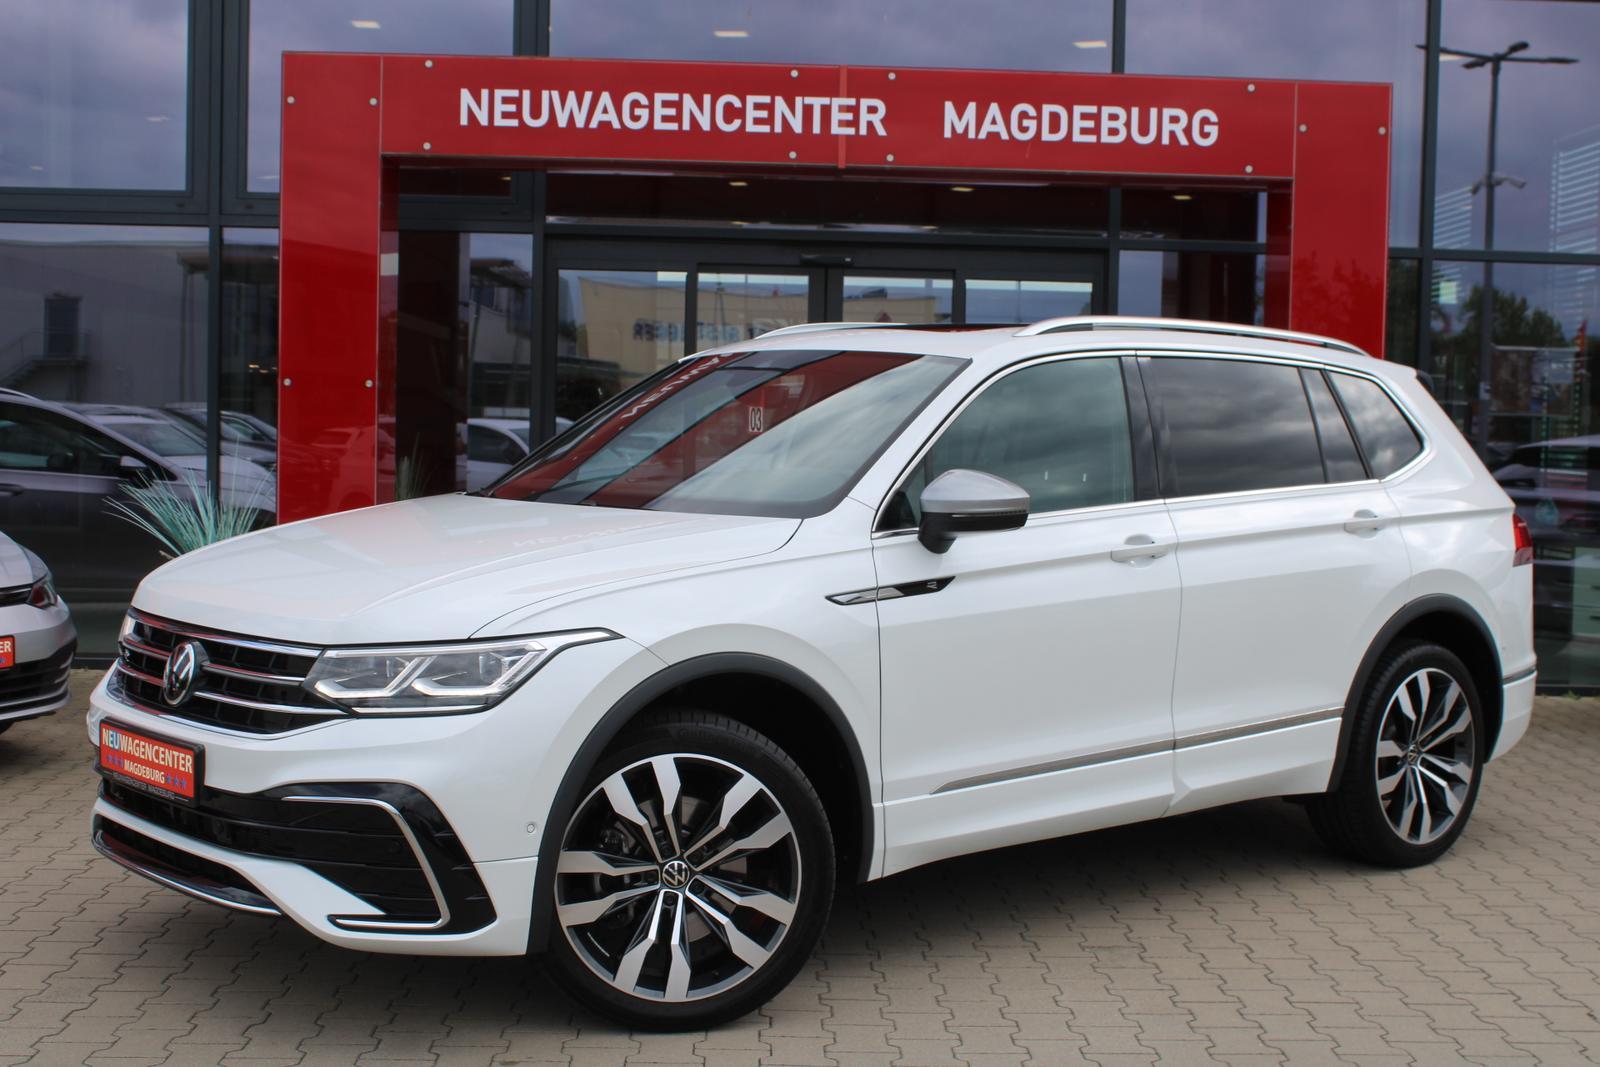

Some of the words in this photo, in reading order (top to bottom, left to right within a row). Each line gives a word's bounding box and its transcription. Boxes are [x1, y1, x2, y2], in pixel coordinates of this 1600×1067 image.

[459, 88, 888, 137] NEUWAGENCENTER
[943, 100, 1219, 147] MAGDEBURG
[750, 407, 762, 431] 03
[102, 727, 193, 773] NEUWAGENCENTER
[124, 759, 165, 784] MAGDEBURG
